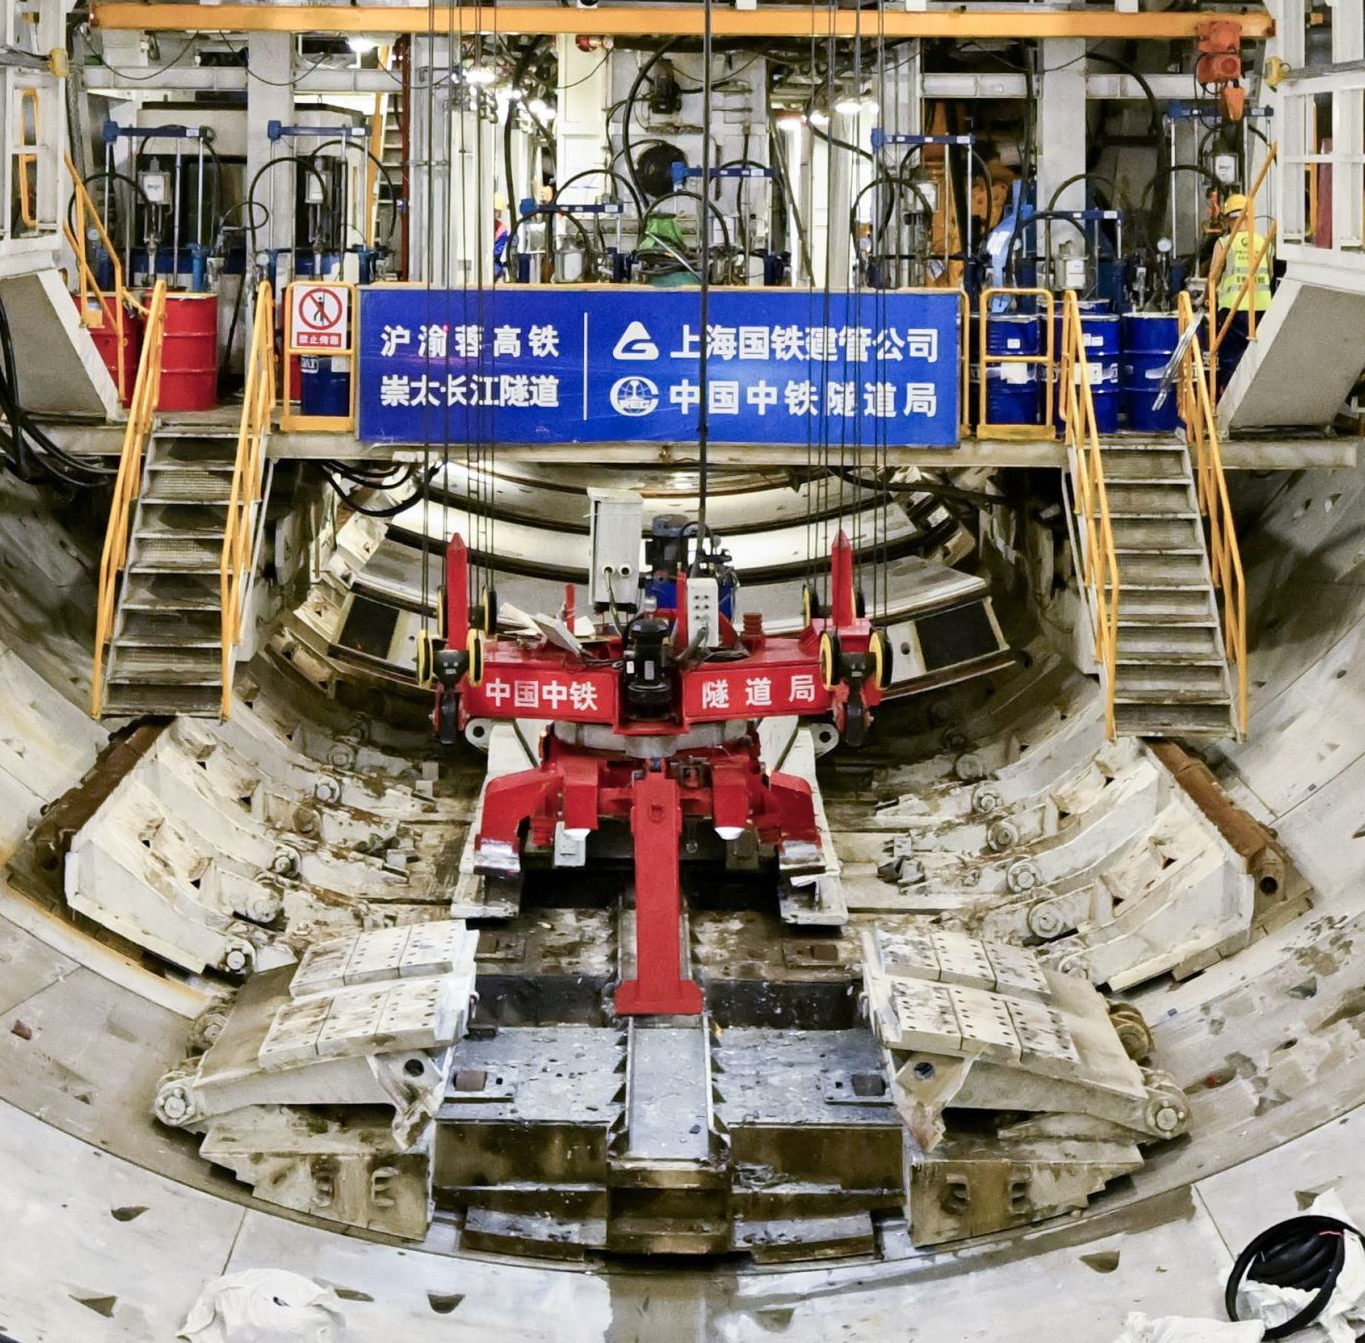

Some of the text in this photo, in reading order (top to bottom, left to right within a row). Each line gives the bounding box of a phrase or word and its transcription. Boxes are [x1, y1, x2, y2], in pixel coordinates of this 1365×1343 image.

[670, 324, 939, 363] 上海国铁建管公司
[380, 374, 560, 408] 崇太长江隧道
[670, 378, 938, 418] 中国中铁隧道局
[485, 674, 816, 710] 中国中铁 隧道局
